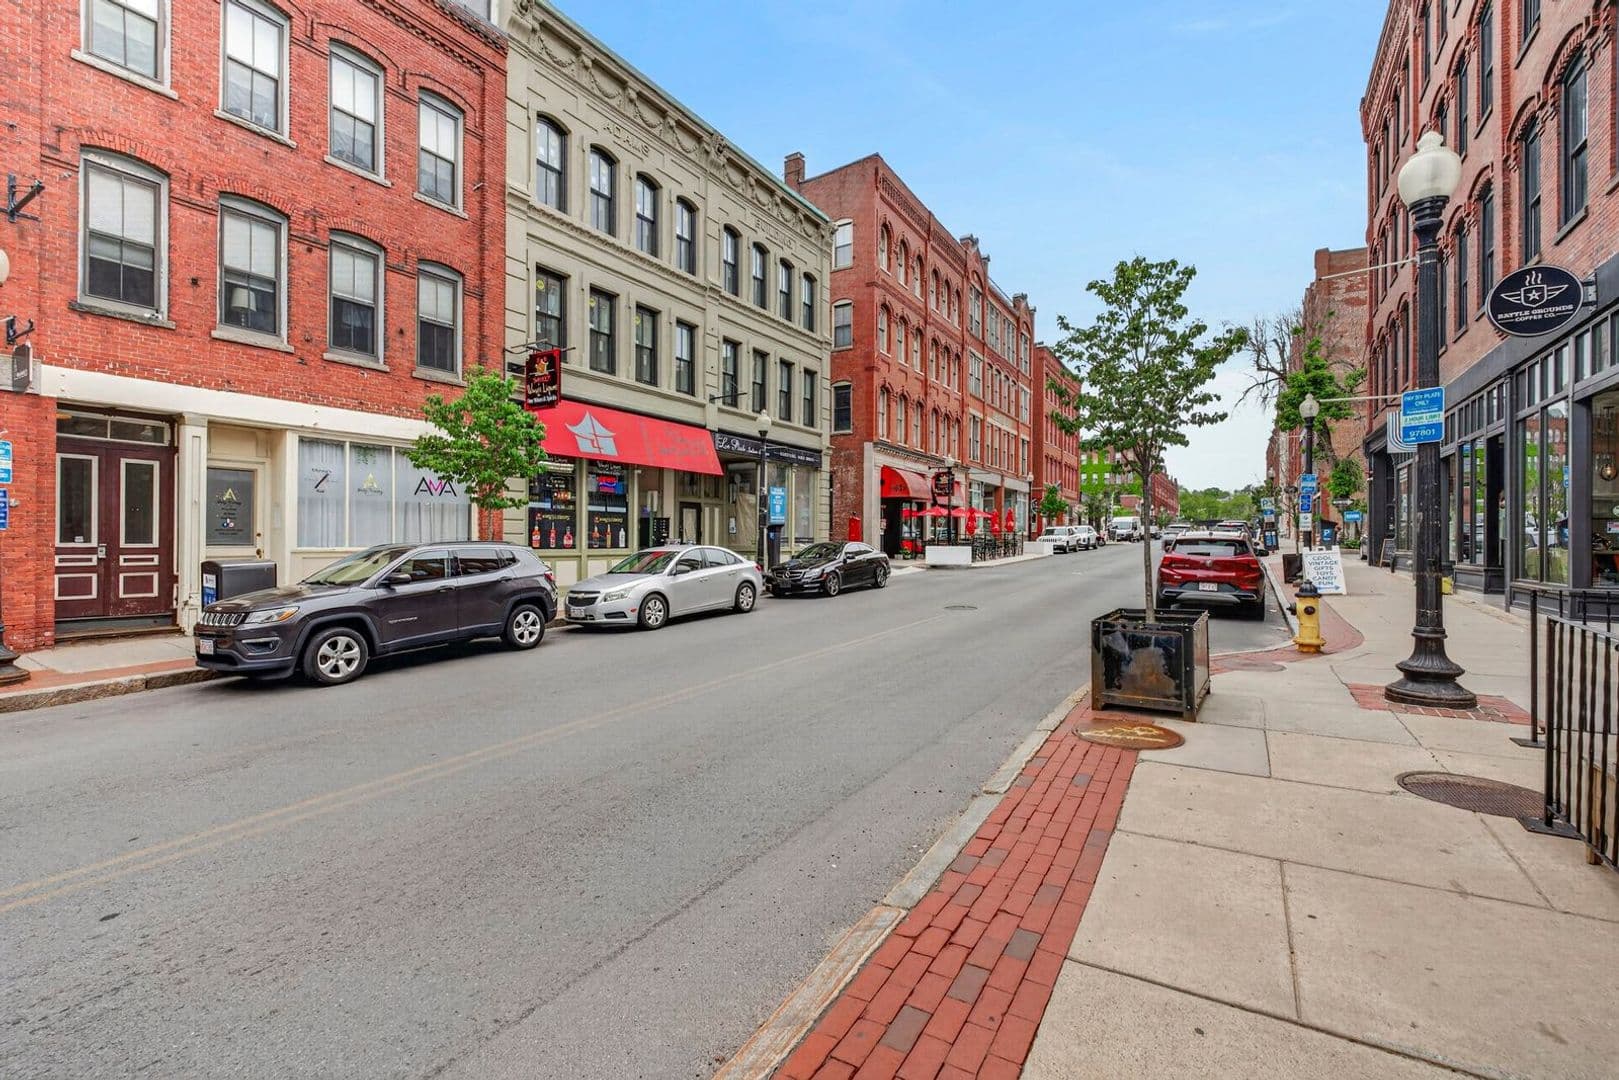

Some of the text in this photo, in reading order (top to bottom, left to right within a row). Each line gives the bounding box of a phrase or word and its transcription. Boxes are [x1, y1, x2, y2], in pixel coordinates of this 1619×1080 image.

[603, 122, 650, 158] ADAMS
[1497, 304, 1574, 320] BATTLE GROUNDS
[1515, 313, 1542, 322] COFFEE
[1409, 428, 1435, 437] 97801
